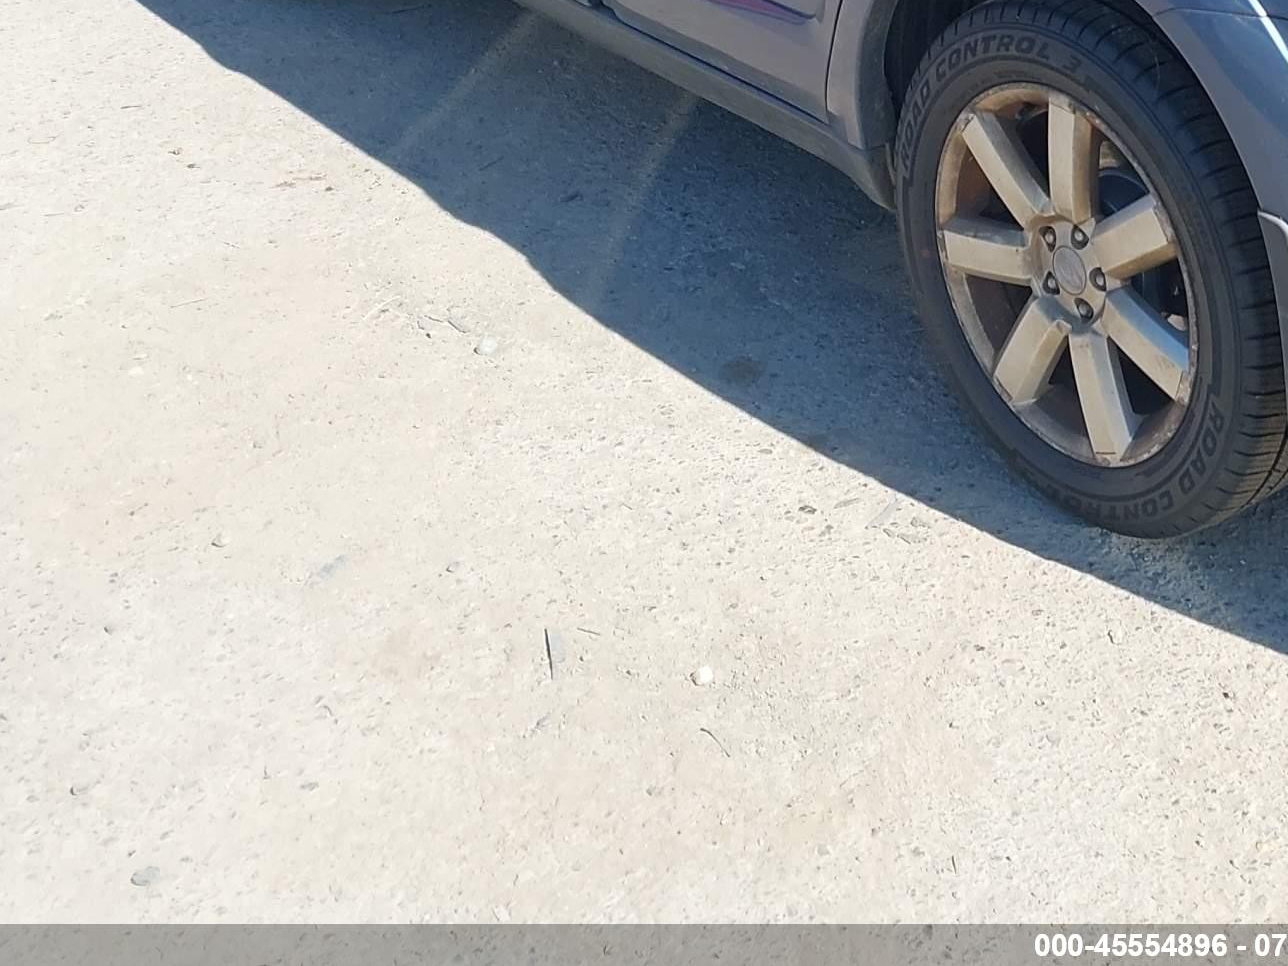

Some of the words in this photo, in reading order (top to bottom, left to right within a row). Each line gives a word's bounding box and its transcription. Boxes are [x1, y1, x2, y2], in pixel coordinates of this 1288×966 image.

[898, 79, 931, 172] ROAD
[935, 33, 1051, 82] CONTROL
[1061, 54, 1082, 75] 3
[1178, 400, 1225, 494] ROAD
